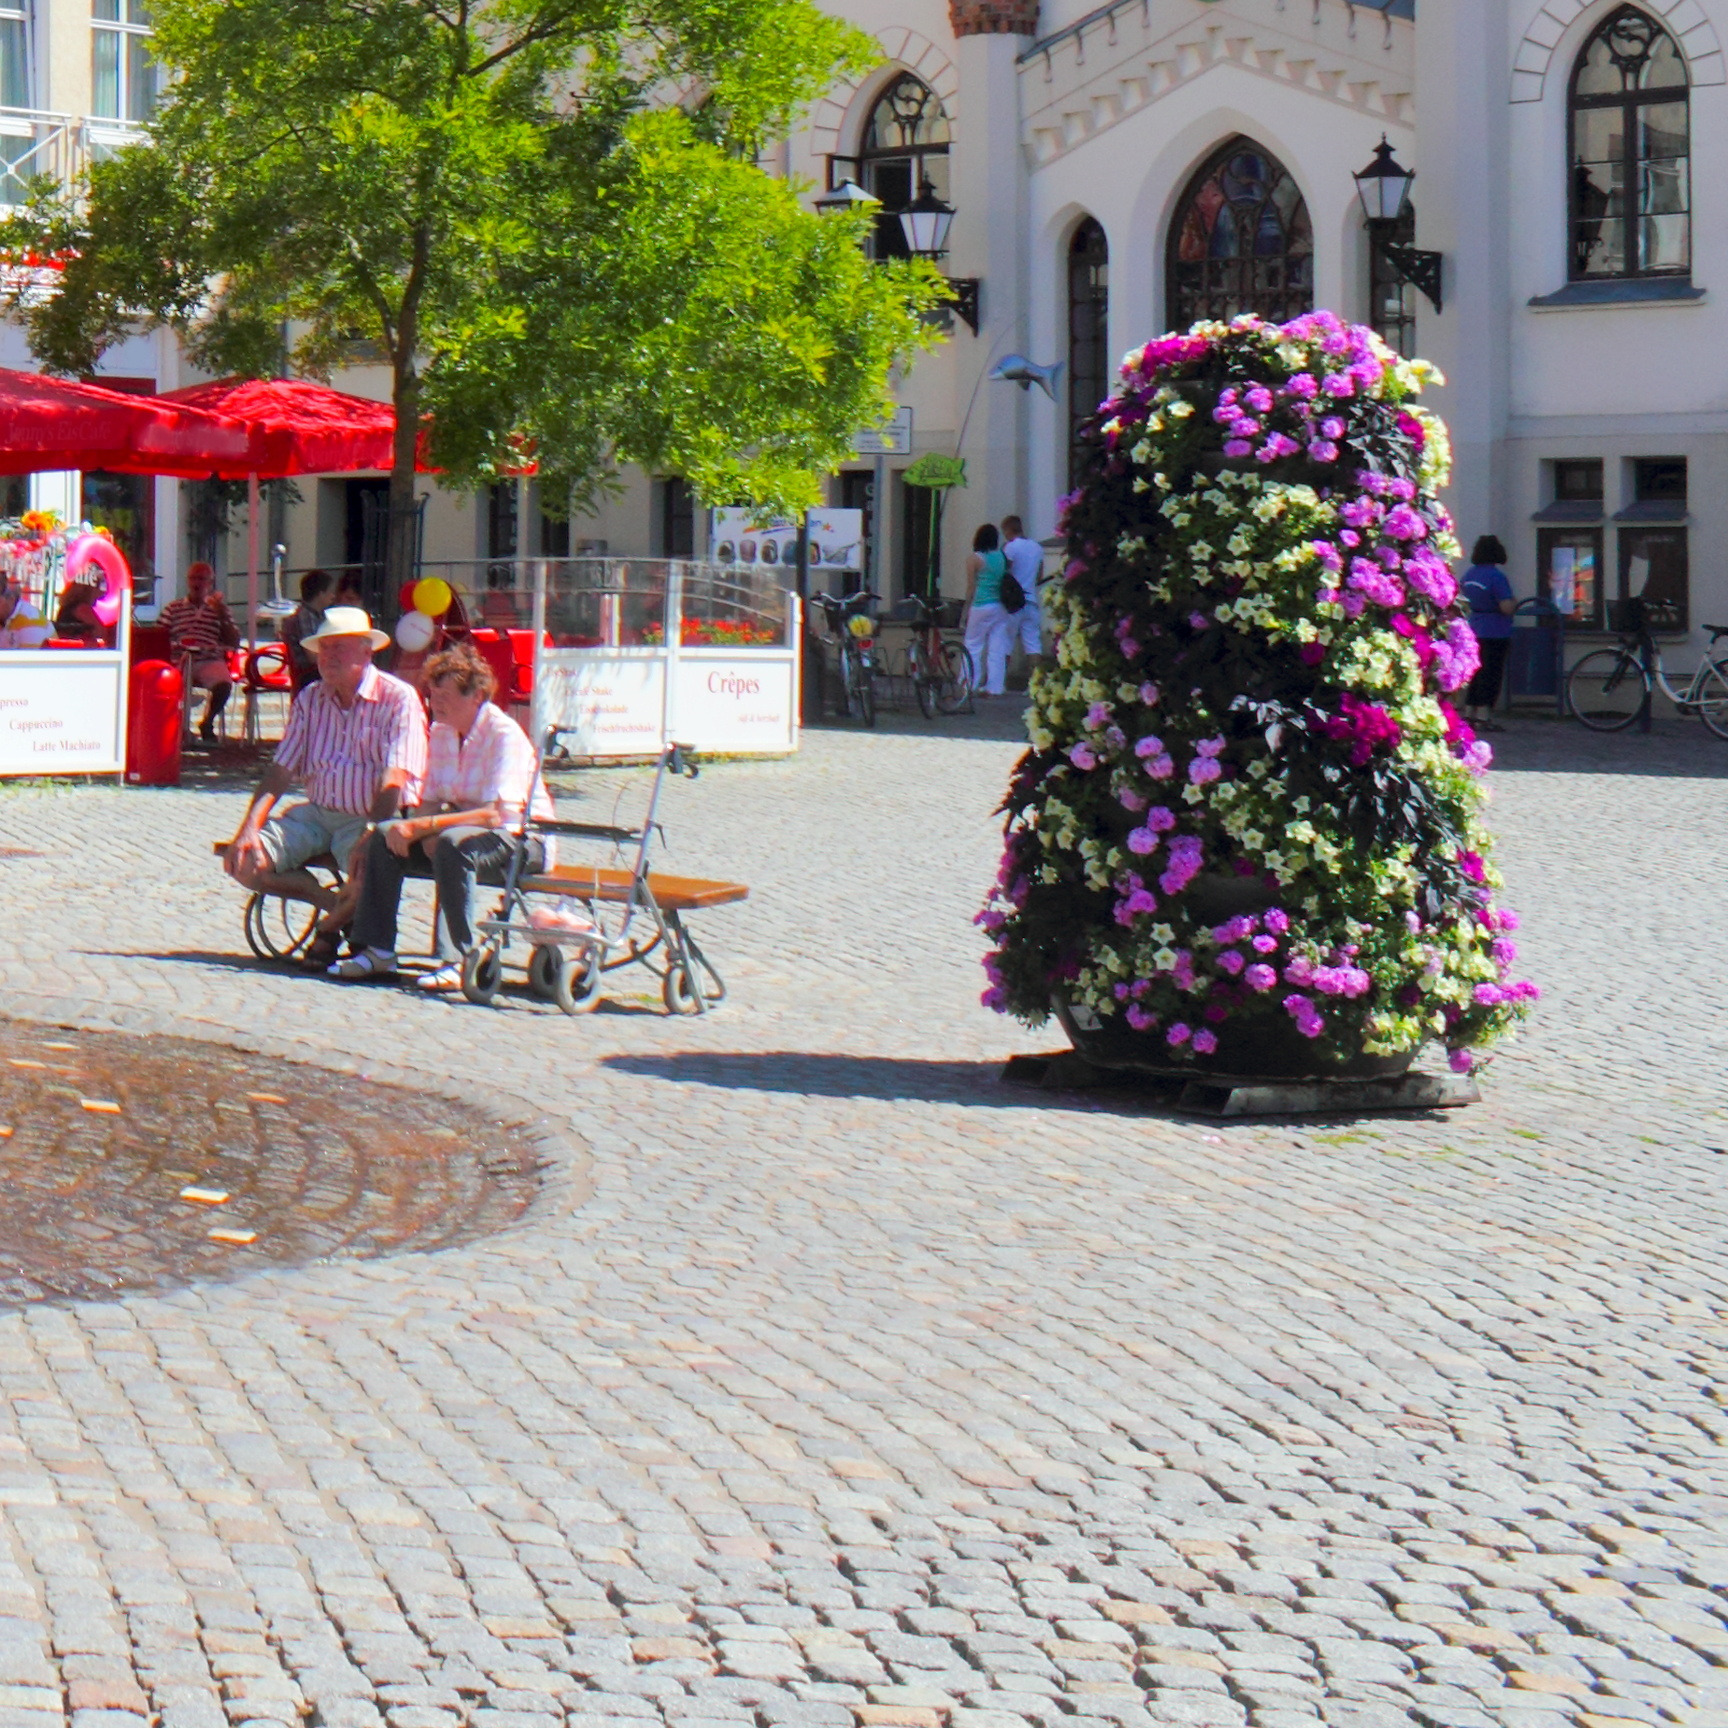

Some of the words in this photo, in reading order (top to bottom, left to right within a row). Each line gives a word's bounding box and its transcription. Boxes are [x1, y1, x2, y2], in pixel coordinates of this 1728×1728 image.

[707, 670, 761, 700] Crêpes
[9, 718, 64, 733] Cappuccino
[32, 740, 57, 752] Latte
